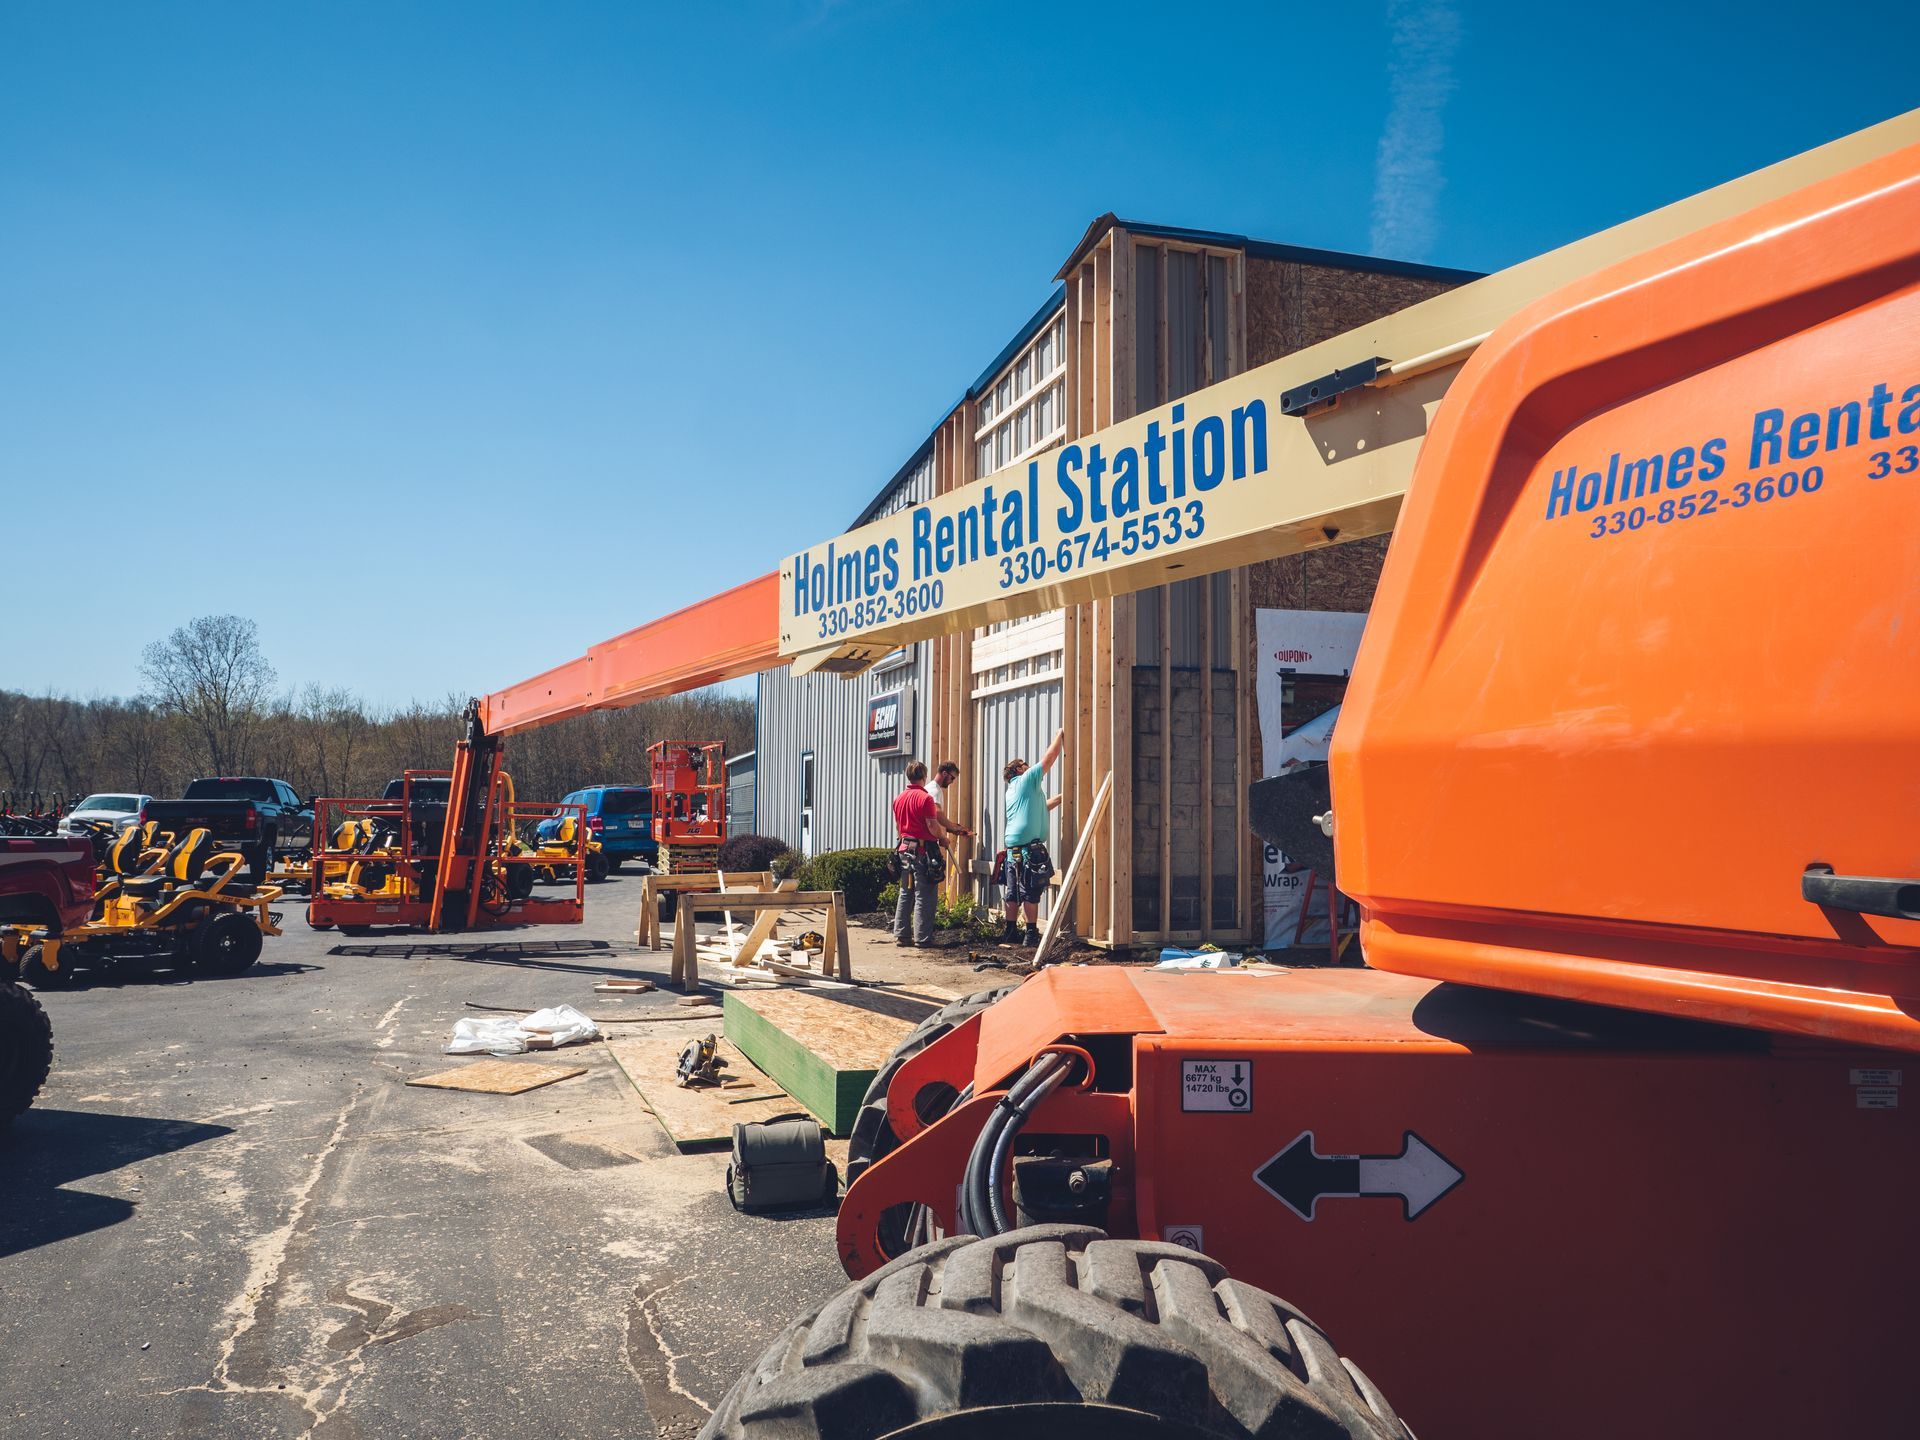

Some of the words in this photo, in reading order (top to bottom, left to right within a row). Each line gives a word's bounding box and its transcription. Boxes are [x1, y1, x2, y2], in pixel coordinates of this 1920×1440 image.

[1546, 438, 1727, 520] Holmes
[794, 535, 899, 617] Holmes
[912, 461, 1039, 581] Rental
[1057, 399, 1268, 534] Station
[1590, 466, 1824, 539] 330-852-3600
[818, 579, 943, 638] 330-852-3600
[1000, 500, 1205, 589] 330-674-5533
[1279, 650, 1309, 663] DUPONT
[873, 704, 897, 731] ECHO
[1186, 1074, 1207, 1082] 6677
[1210, 1074, 1222, 1084] kg
[1195, 1065, 1216, 1073] MAX
[1186, 1085, 1213, 1093] 14720
[1215, 1085, 1230, 1093] lbs
